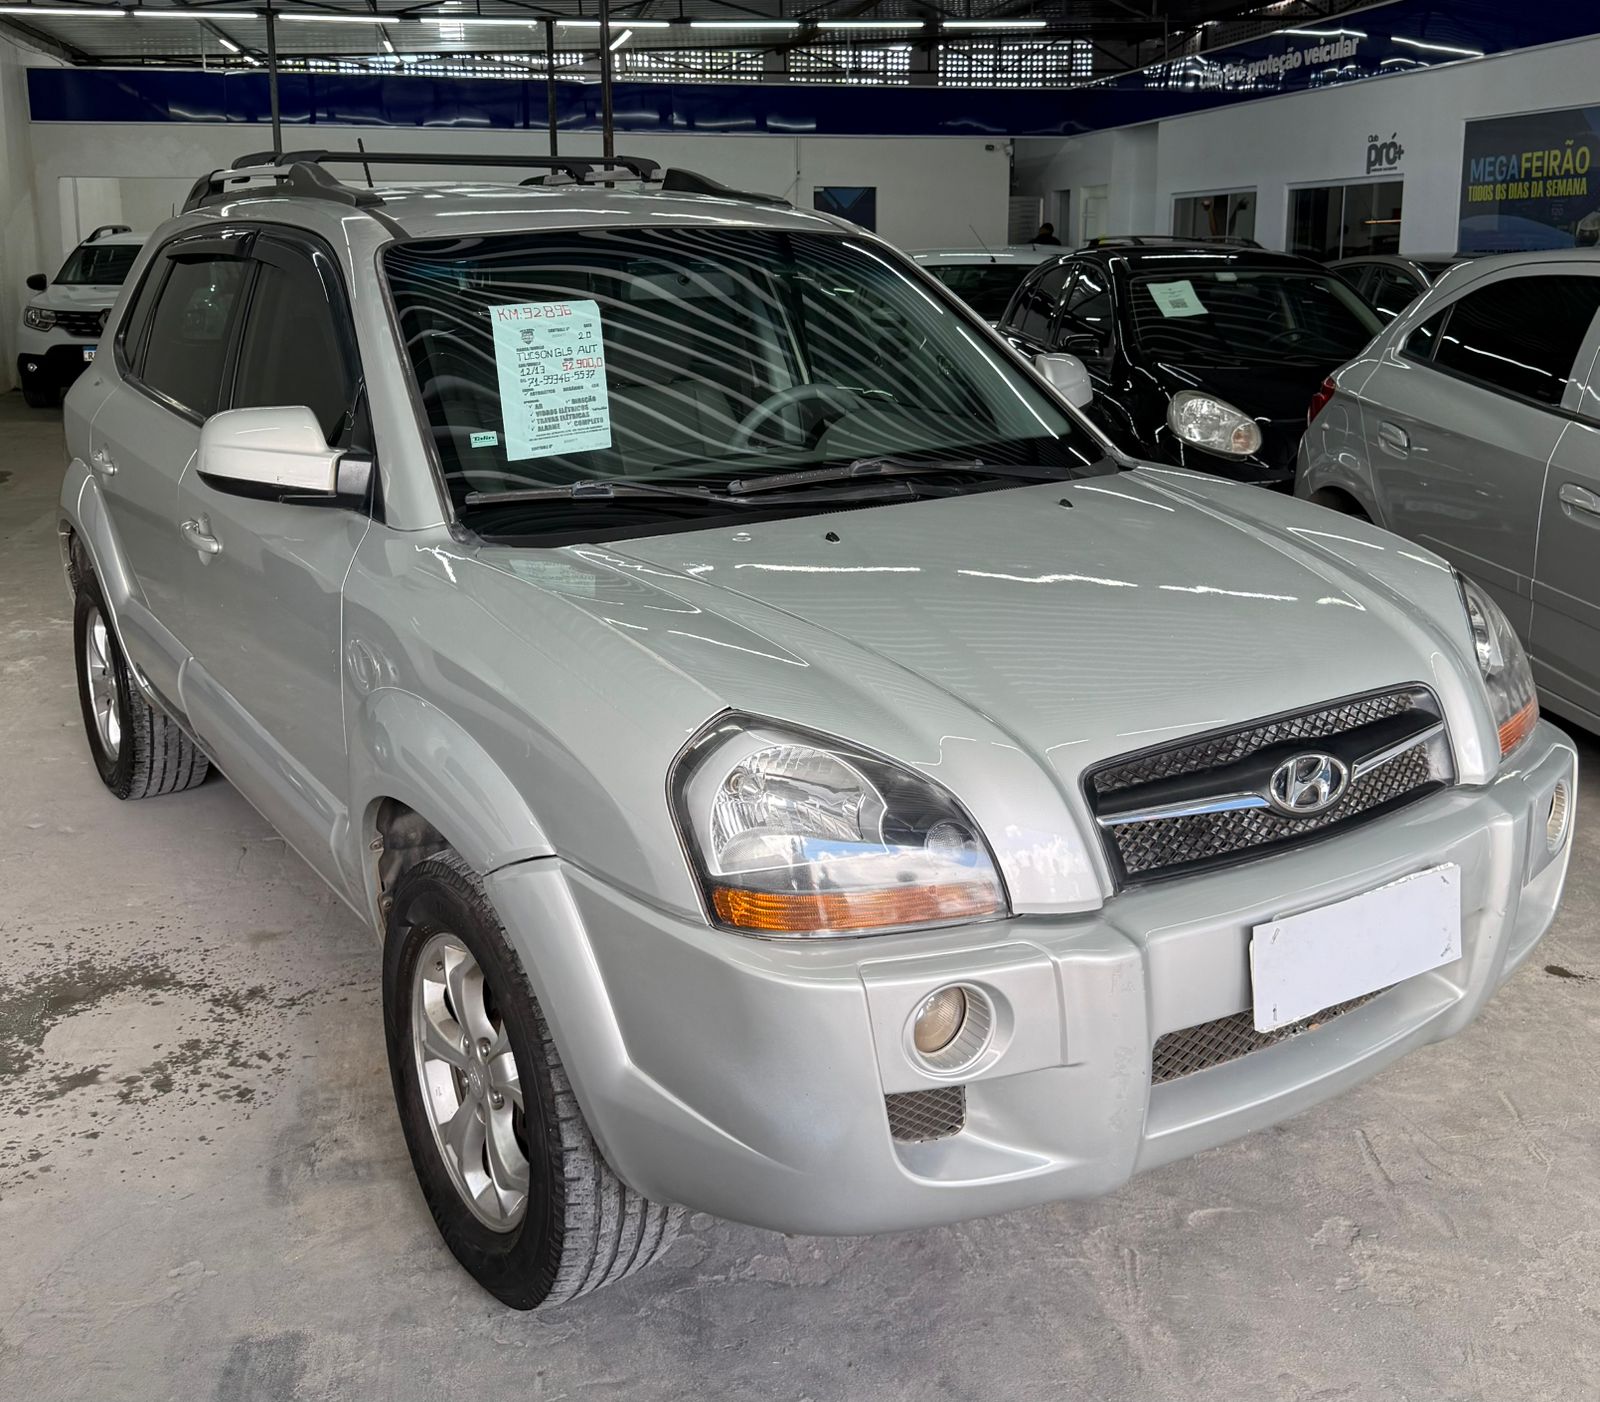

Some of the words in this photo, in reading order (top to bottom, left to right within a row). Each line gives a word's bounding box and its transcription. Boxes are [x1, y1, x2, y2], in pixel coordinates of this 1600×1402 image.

[1247, 46, 1301, 84] proteção
[1304, 35, 1359, 66] veicular
[1468, 184, 1494, 202] TODOS
[1495, 183, 1507, 200] OS
[1508, 181, 1530, 200] DIAS
[1531, 180, 1544, 198] DA
[1546, 177, 1588, 197] SEMANA
[554, 347, 573, 358] GLS
[577, 344, 598, 355] AUT
